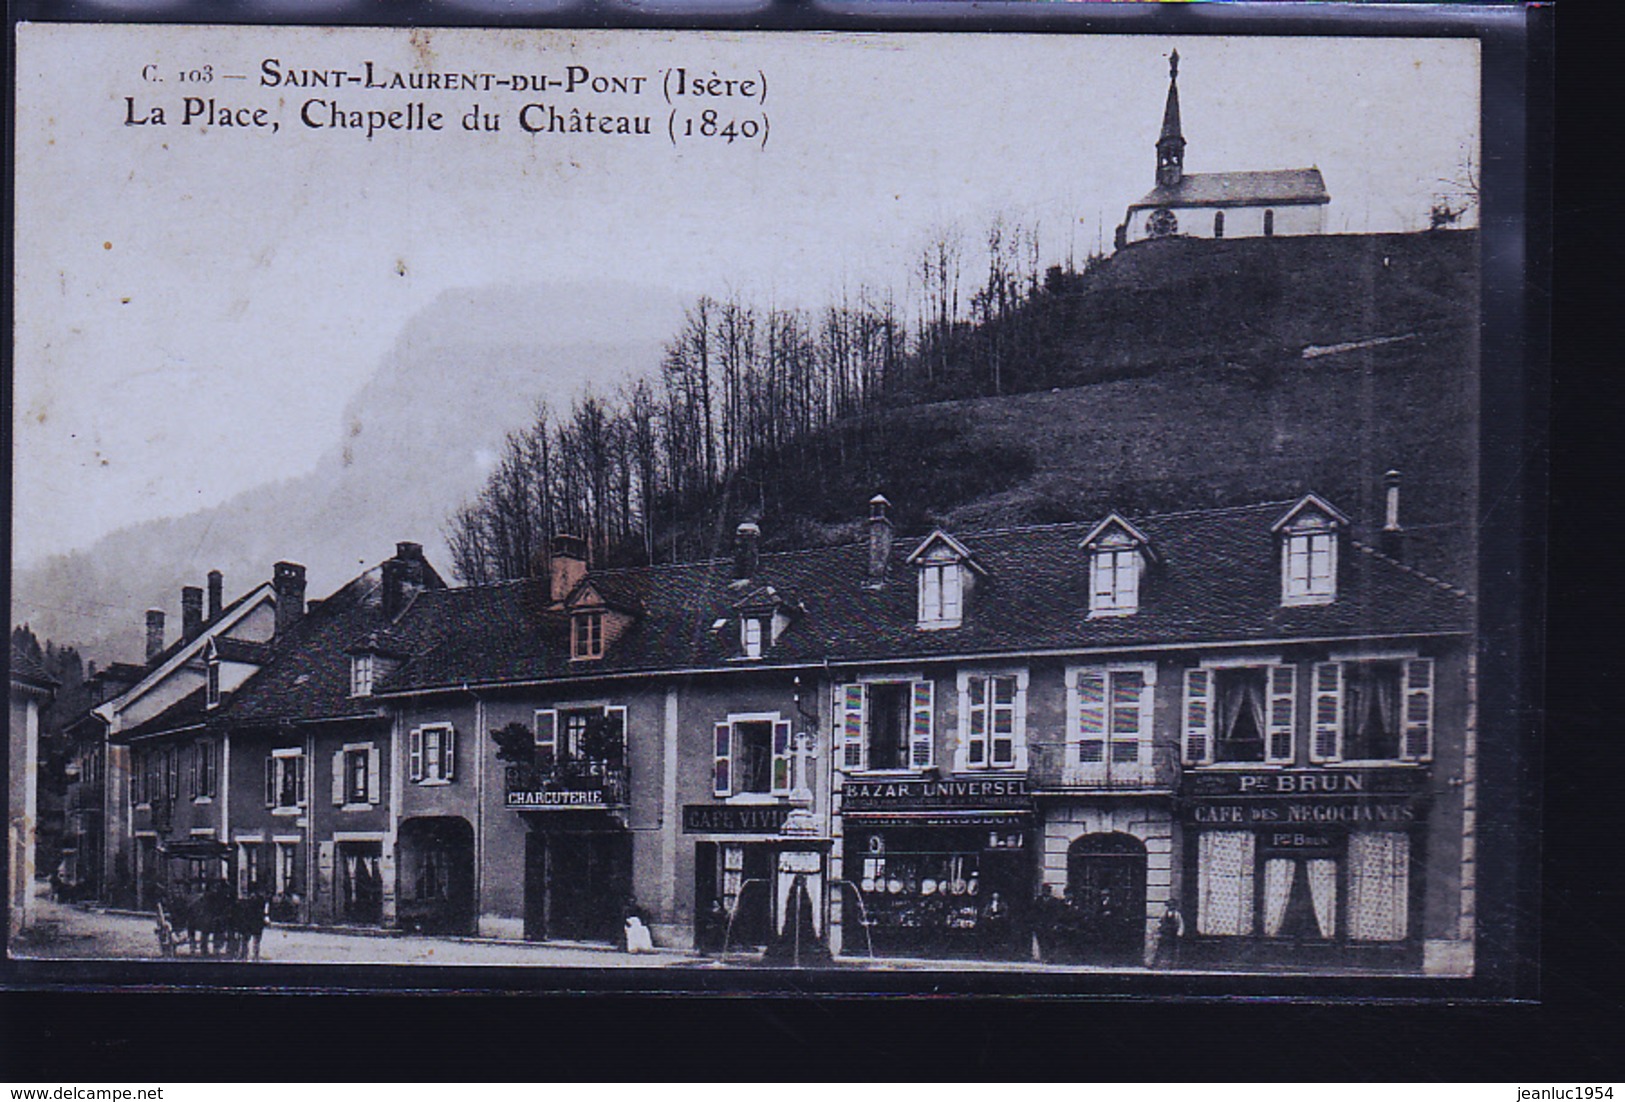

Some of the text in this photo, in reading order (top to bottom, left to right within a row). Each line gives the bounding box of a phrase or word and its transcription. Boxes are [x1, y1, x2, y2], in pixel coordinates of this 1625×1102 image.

[142, 64, 164, 82] C.
[179, 64, 214, 83] 103
[662, 67, 768, 104] (Isère)
[124, 97, 770, 149] La Place, Chapelle du Château (1840)
[846, 781, 1030, 797] BAZAR UNIVERSEL
[1276, 774, 1363, 792] BRUN
[508, 790, 602, 804] CHARCUTERIE
